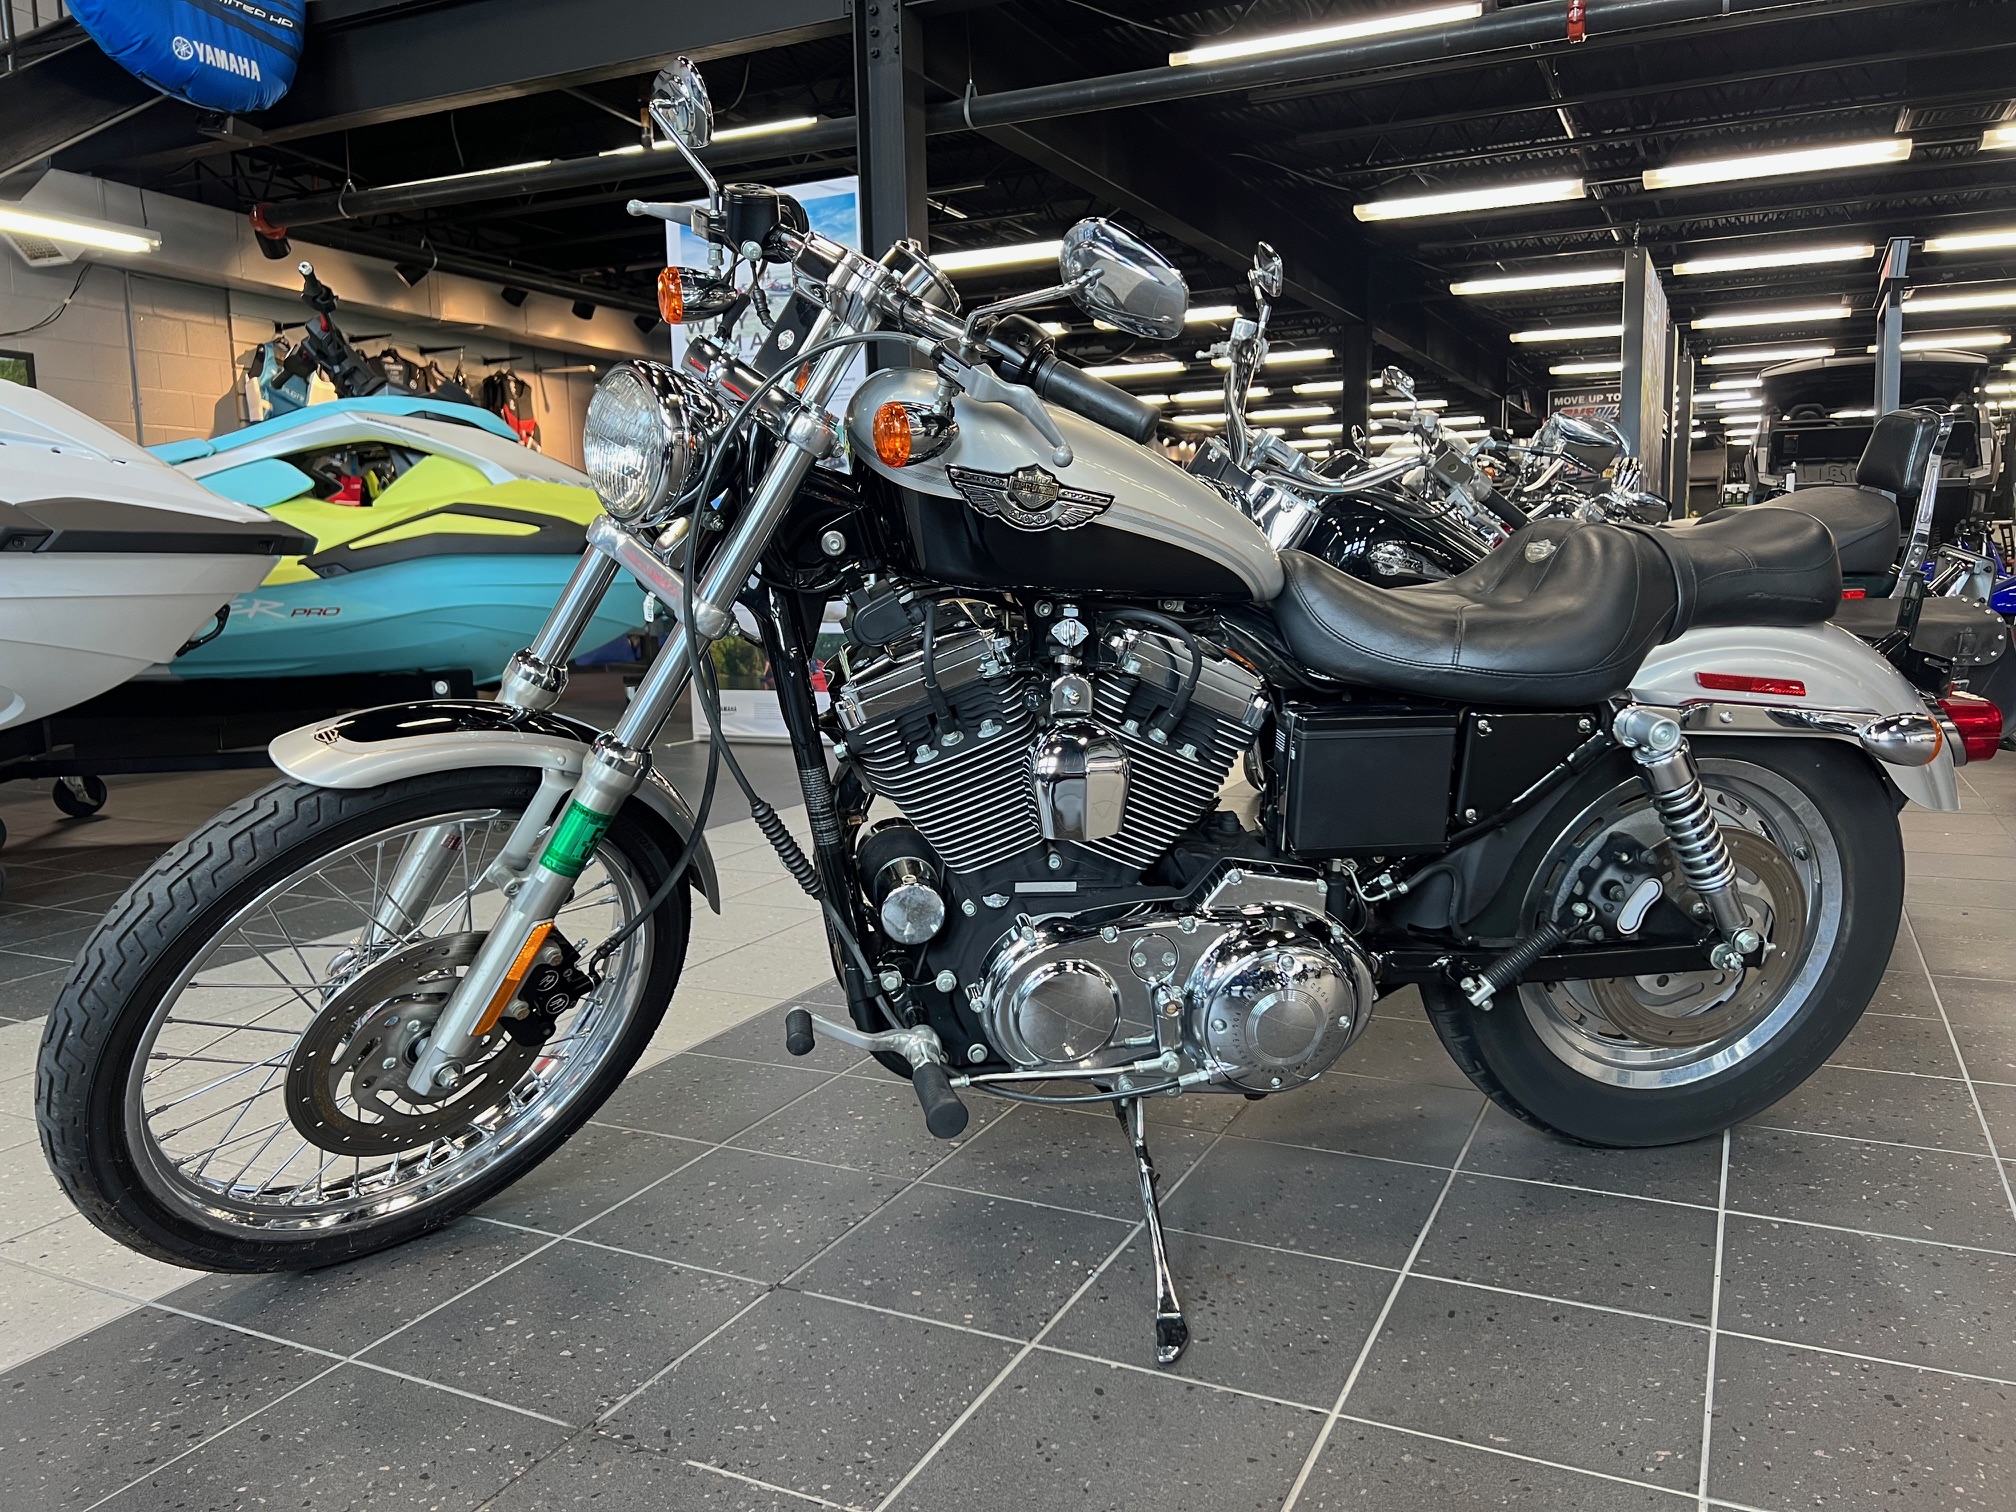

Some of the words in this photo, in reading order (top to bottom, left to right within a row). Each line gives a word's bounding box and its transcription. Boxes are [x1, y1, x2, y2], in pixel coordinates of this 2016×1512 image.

[269, 14, 294, 28] HD
[193, 40, 261, 82] YAMAHA
[1554, 395, 1585, 406] MOVE
[1588, 394, 1604, 403] UP
[1606, 392, 1622, 402] TO
[290, 606, 341, 617] PRO
